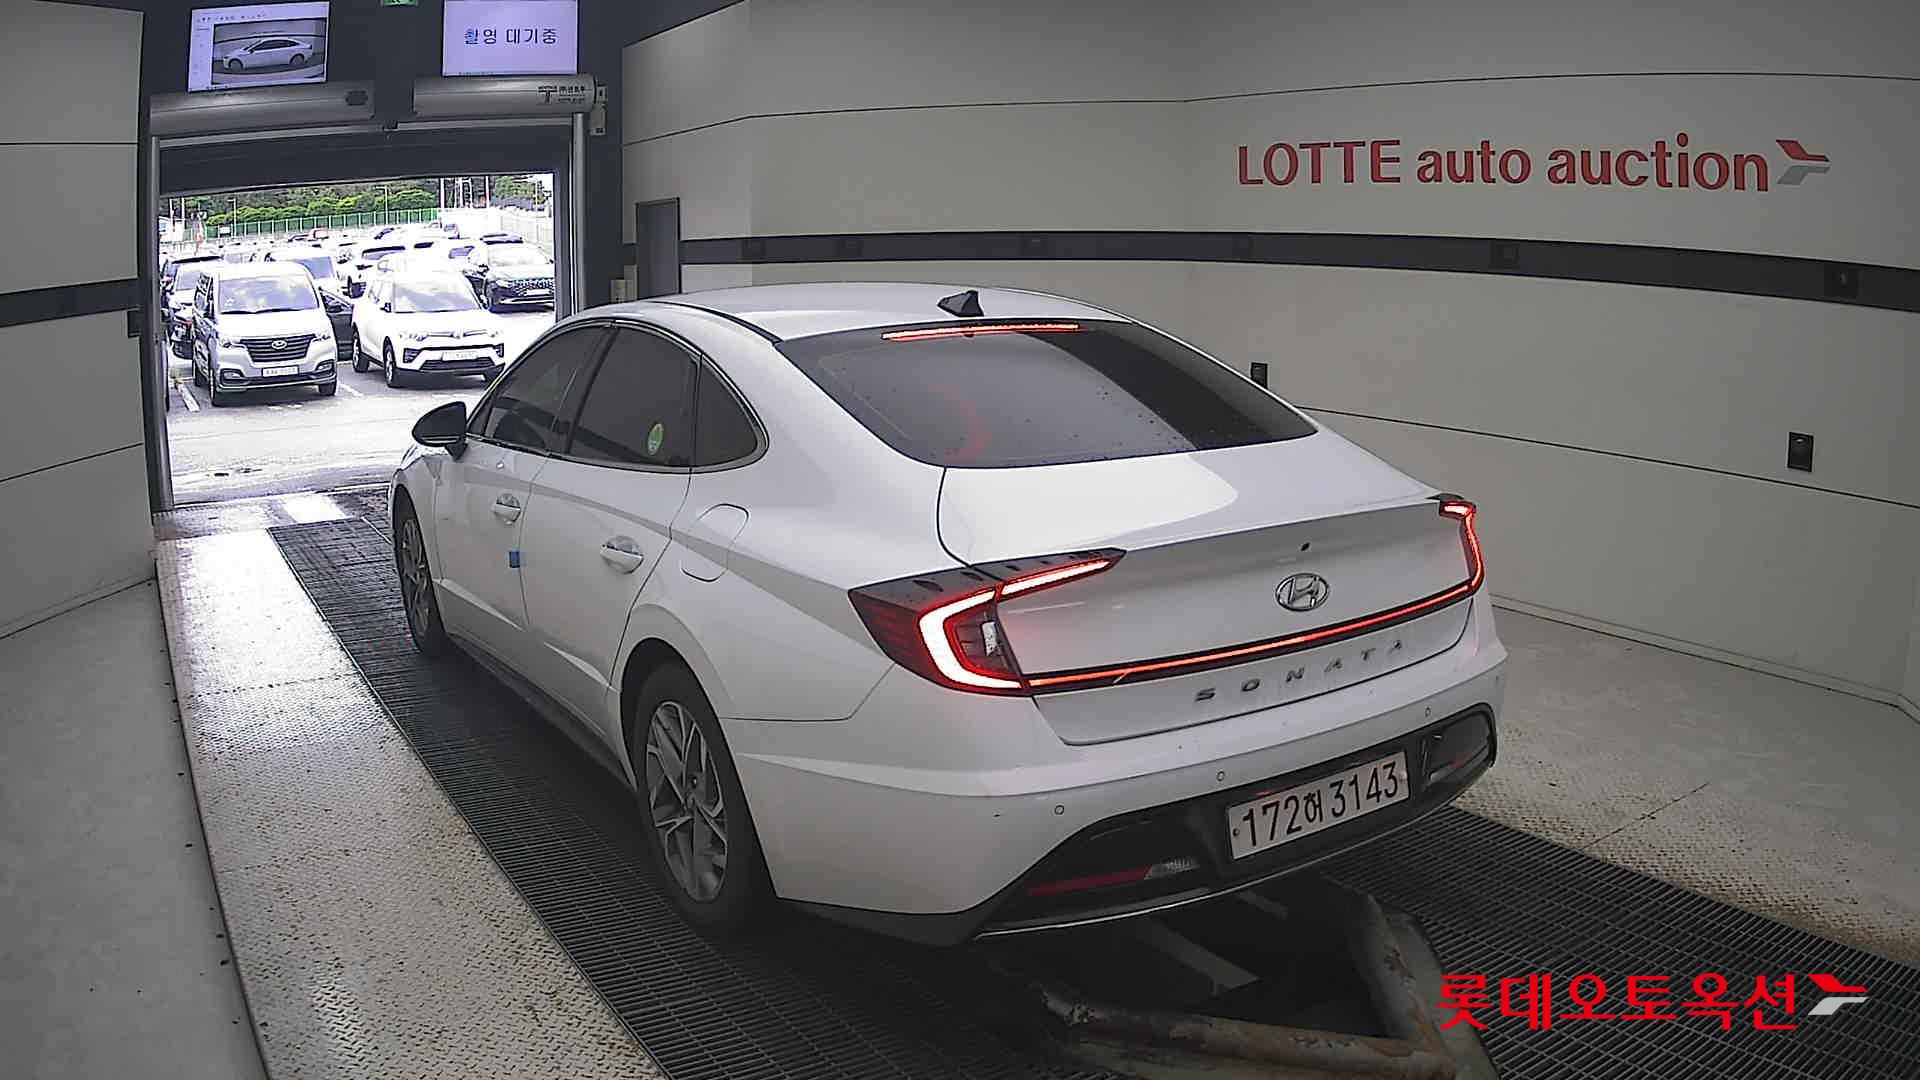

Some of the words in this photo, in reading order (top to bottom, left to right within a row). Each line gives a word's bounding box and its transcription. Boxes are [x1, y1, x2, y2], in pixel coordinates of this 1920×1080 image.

[505, 27, 557, 45] 대기중
[1238, 140, 1400, 185] LOTTE
[1417, 141, 1532, 184] auto
[1548, 133, 1769, 190] auction
[1194, 639, 1403, 702] SONATA
[1242, 791, 1323, 847] 172허
[1329, 760, 1398, 818] 3143
